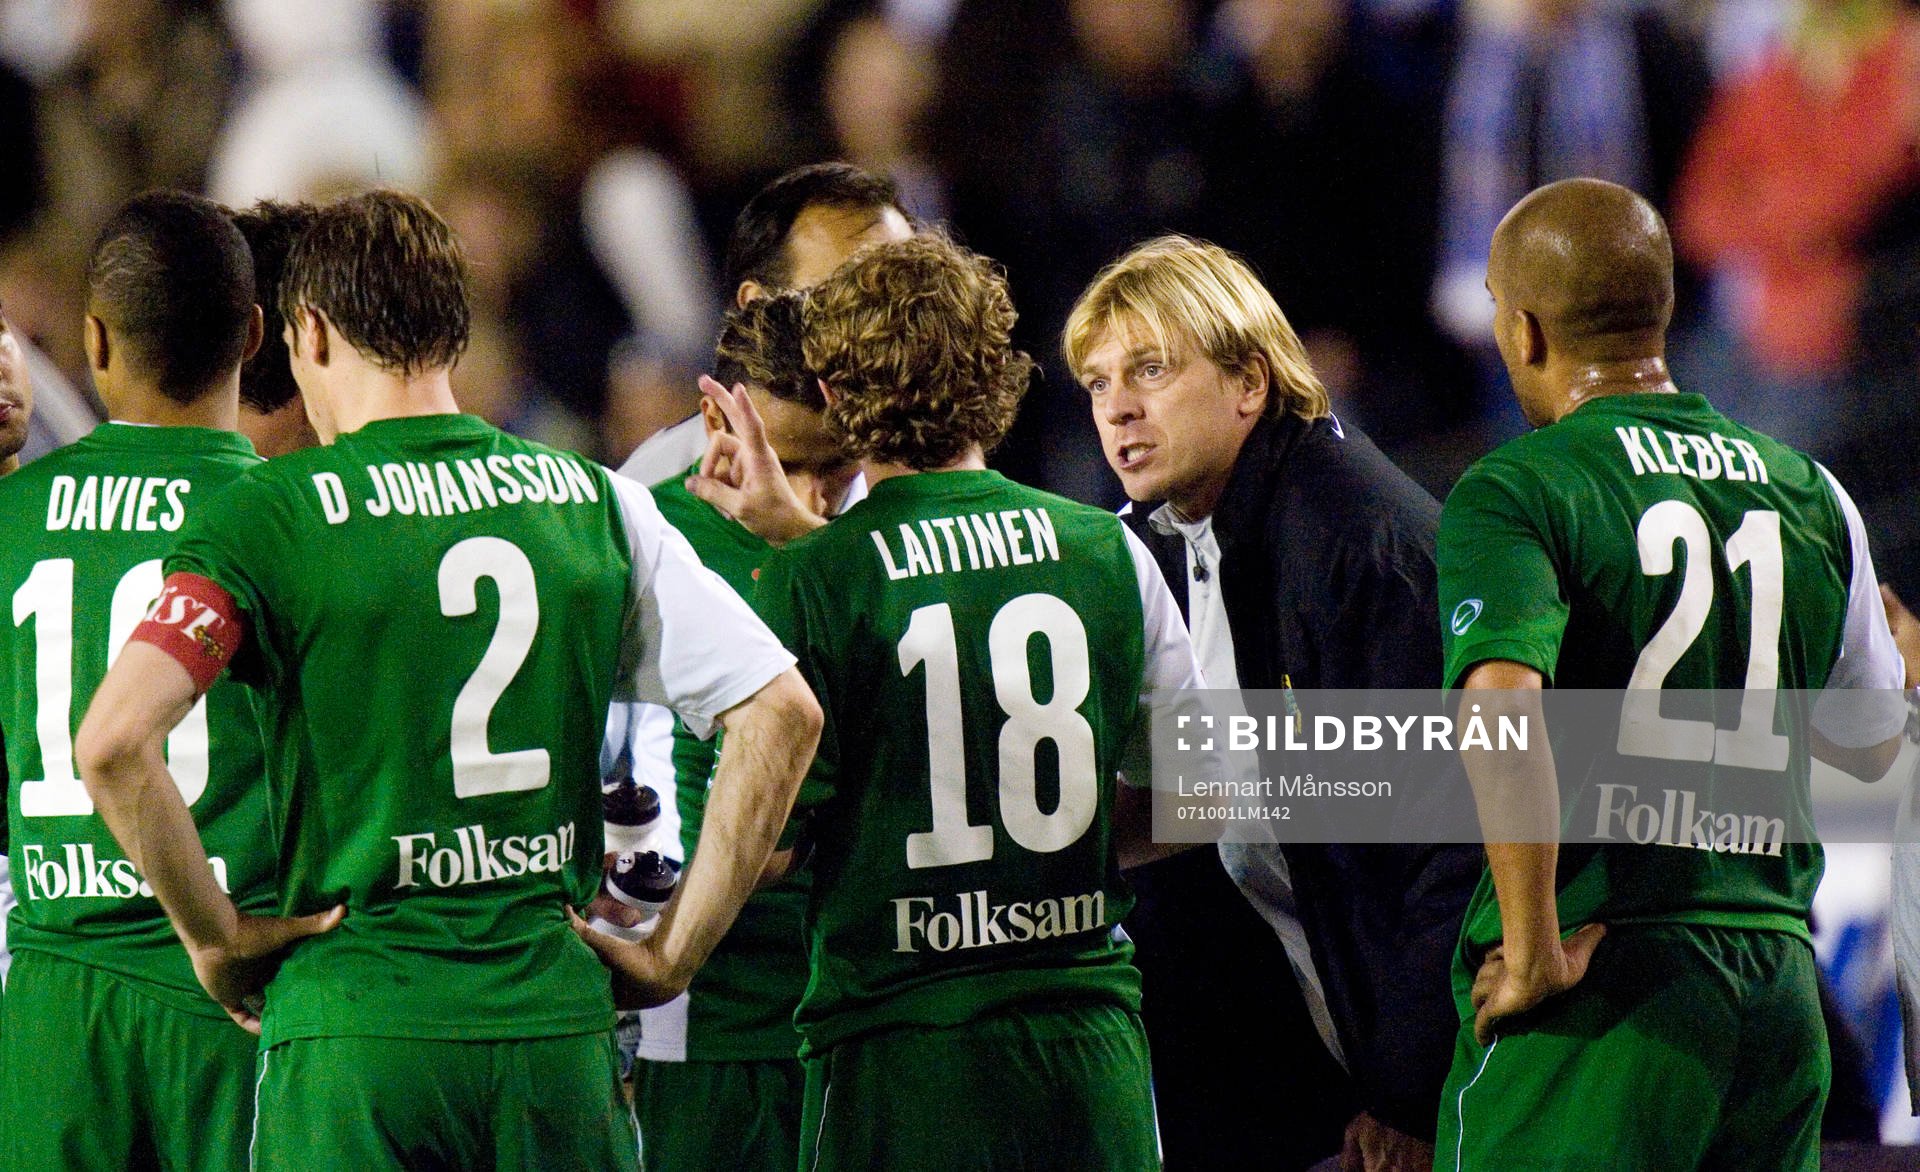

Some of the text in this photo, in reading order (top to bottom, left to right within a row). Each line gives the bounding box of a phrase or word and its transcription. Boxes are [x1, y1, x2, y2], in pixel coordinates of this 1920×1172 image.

[311, 453, 599, 525] D JOHANSSON
[1615, 426, 1769, 485] KLEBER
[47, 475, 191, 532] DAVIES
[870, 508, 1060, 581] LAITINEN
[437, 536, 551, 799] 2
[1616, 499, 1790, 772] 21
[897, 592, 1098, 869] 18
[22, 843, 231, 900] Folks
[892, 890, 1106, 953] Folksam
